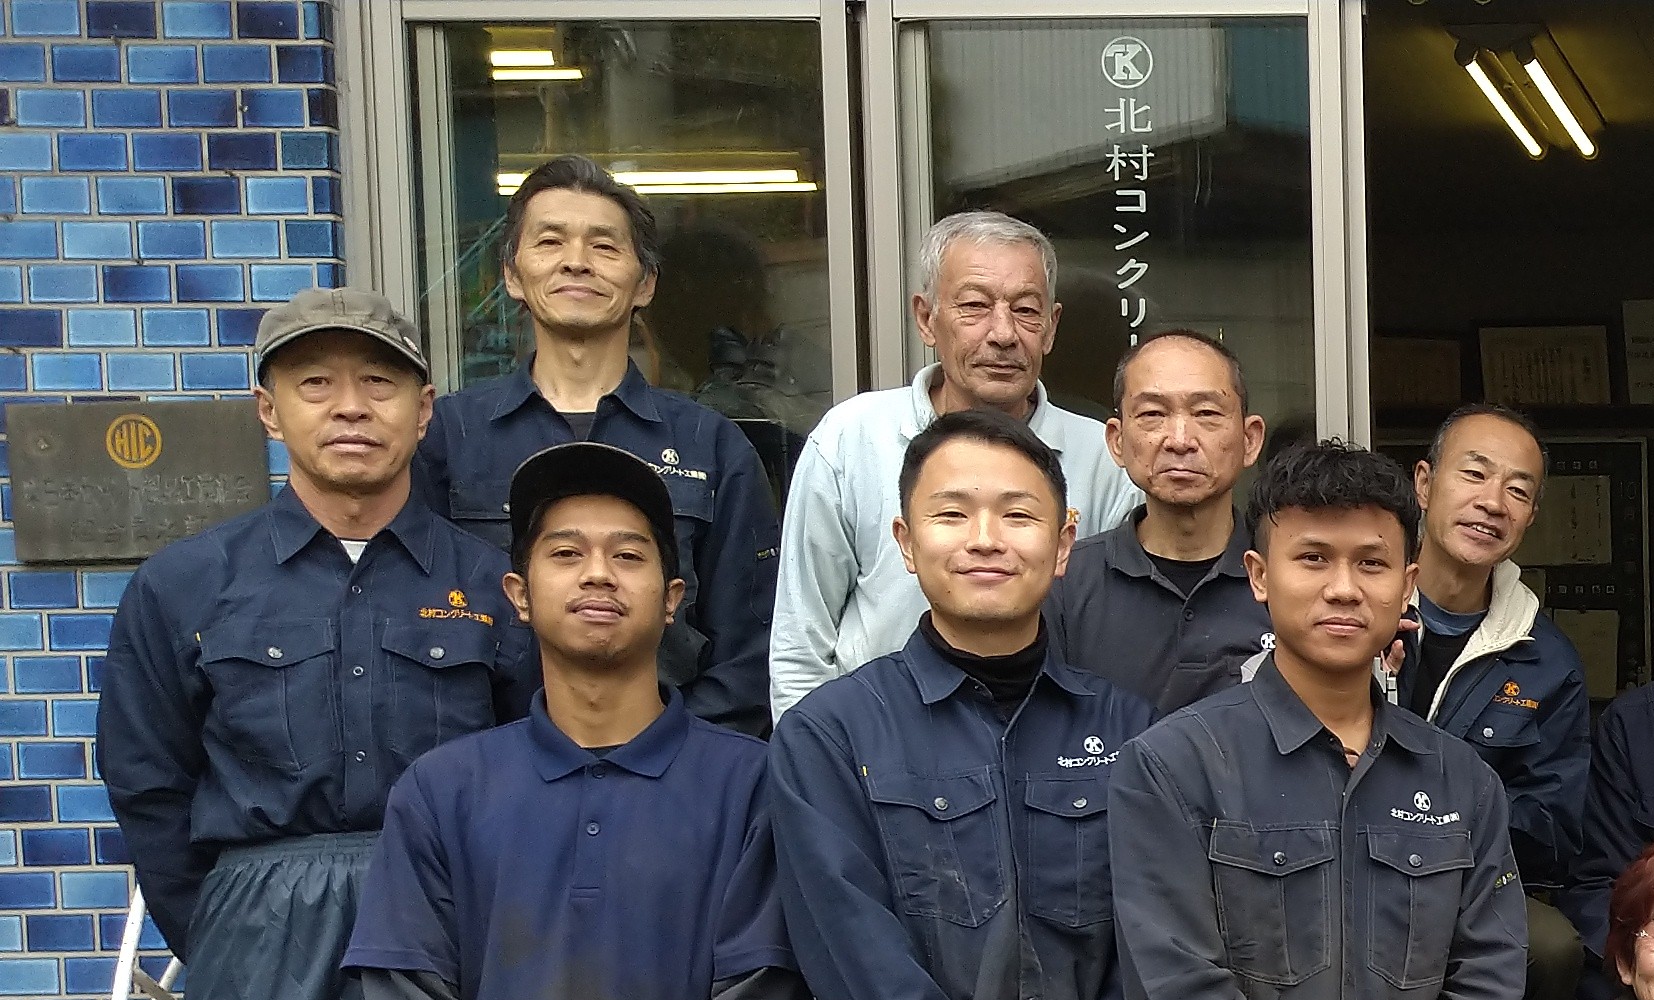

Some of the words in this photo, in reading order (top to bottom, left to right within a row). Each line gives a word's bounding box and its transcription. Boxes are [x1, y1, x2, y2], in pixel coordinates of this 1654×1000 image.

[1057, 751, 1121, 768] 北村コンクリート工
